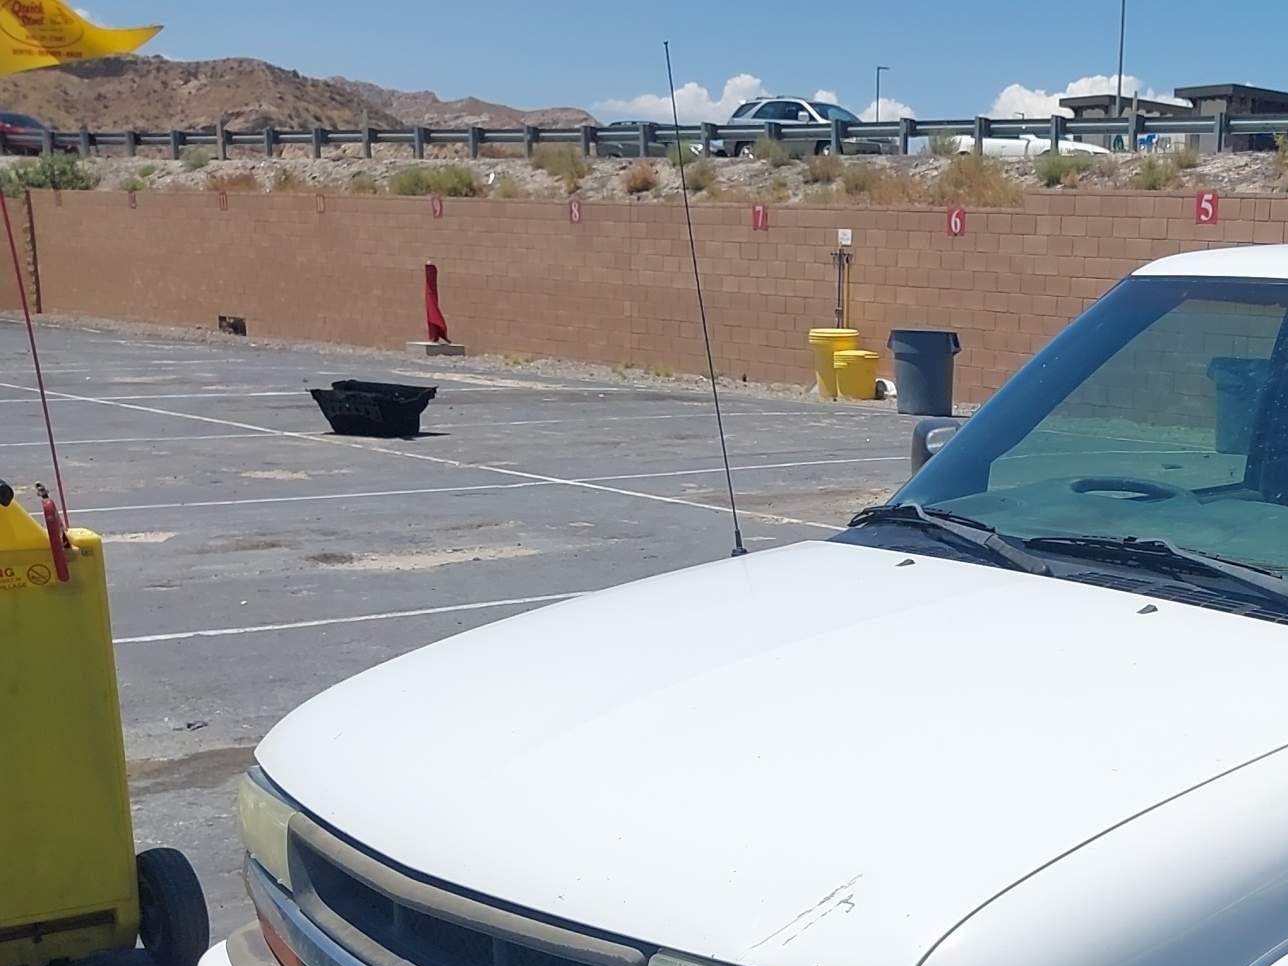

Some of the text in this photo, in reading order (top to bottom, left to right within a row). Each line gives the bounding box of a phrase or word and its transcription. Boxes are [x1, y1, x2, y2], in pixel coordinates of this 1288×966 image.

[433, 199, 441, 217] 9
[571, 201, 580, 222] 8
[754, 206, 764, 228] 7
[1200, 193, 1213, 221] 5
[951, 209, 961, 233] 6
